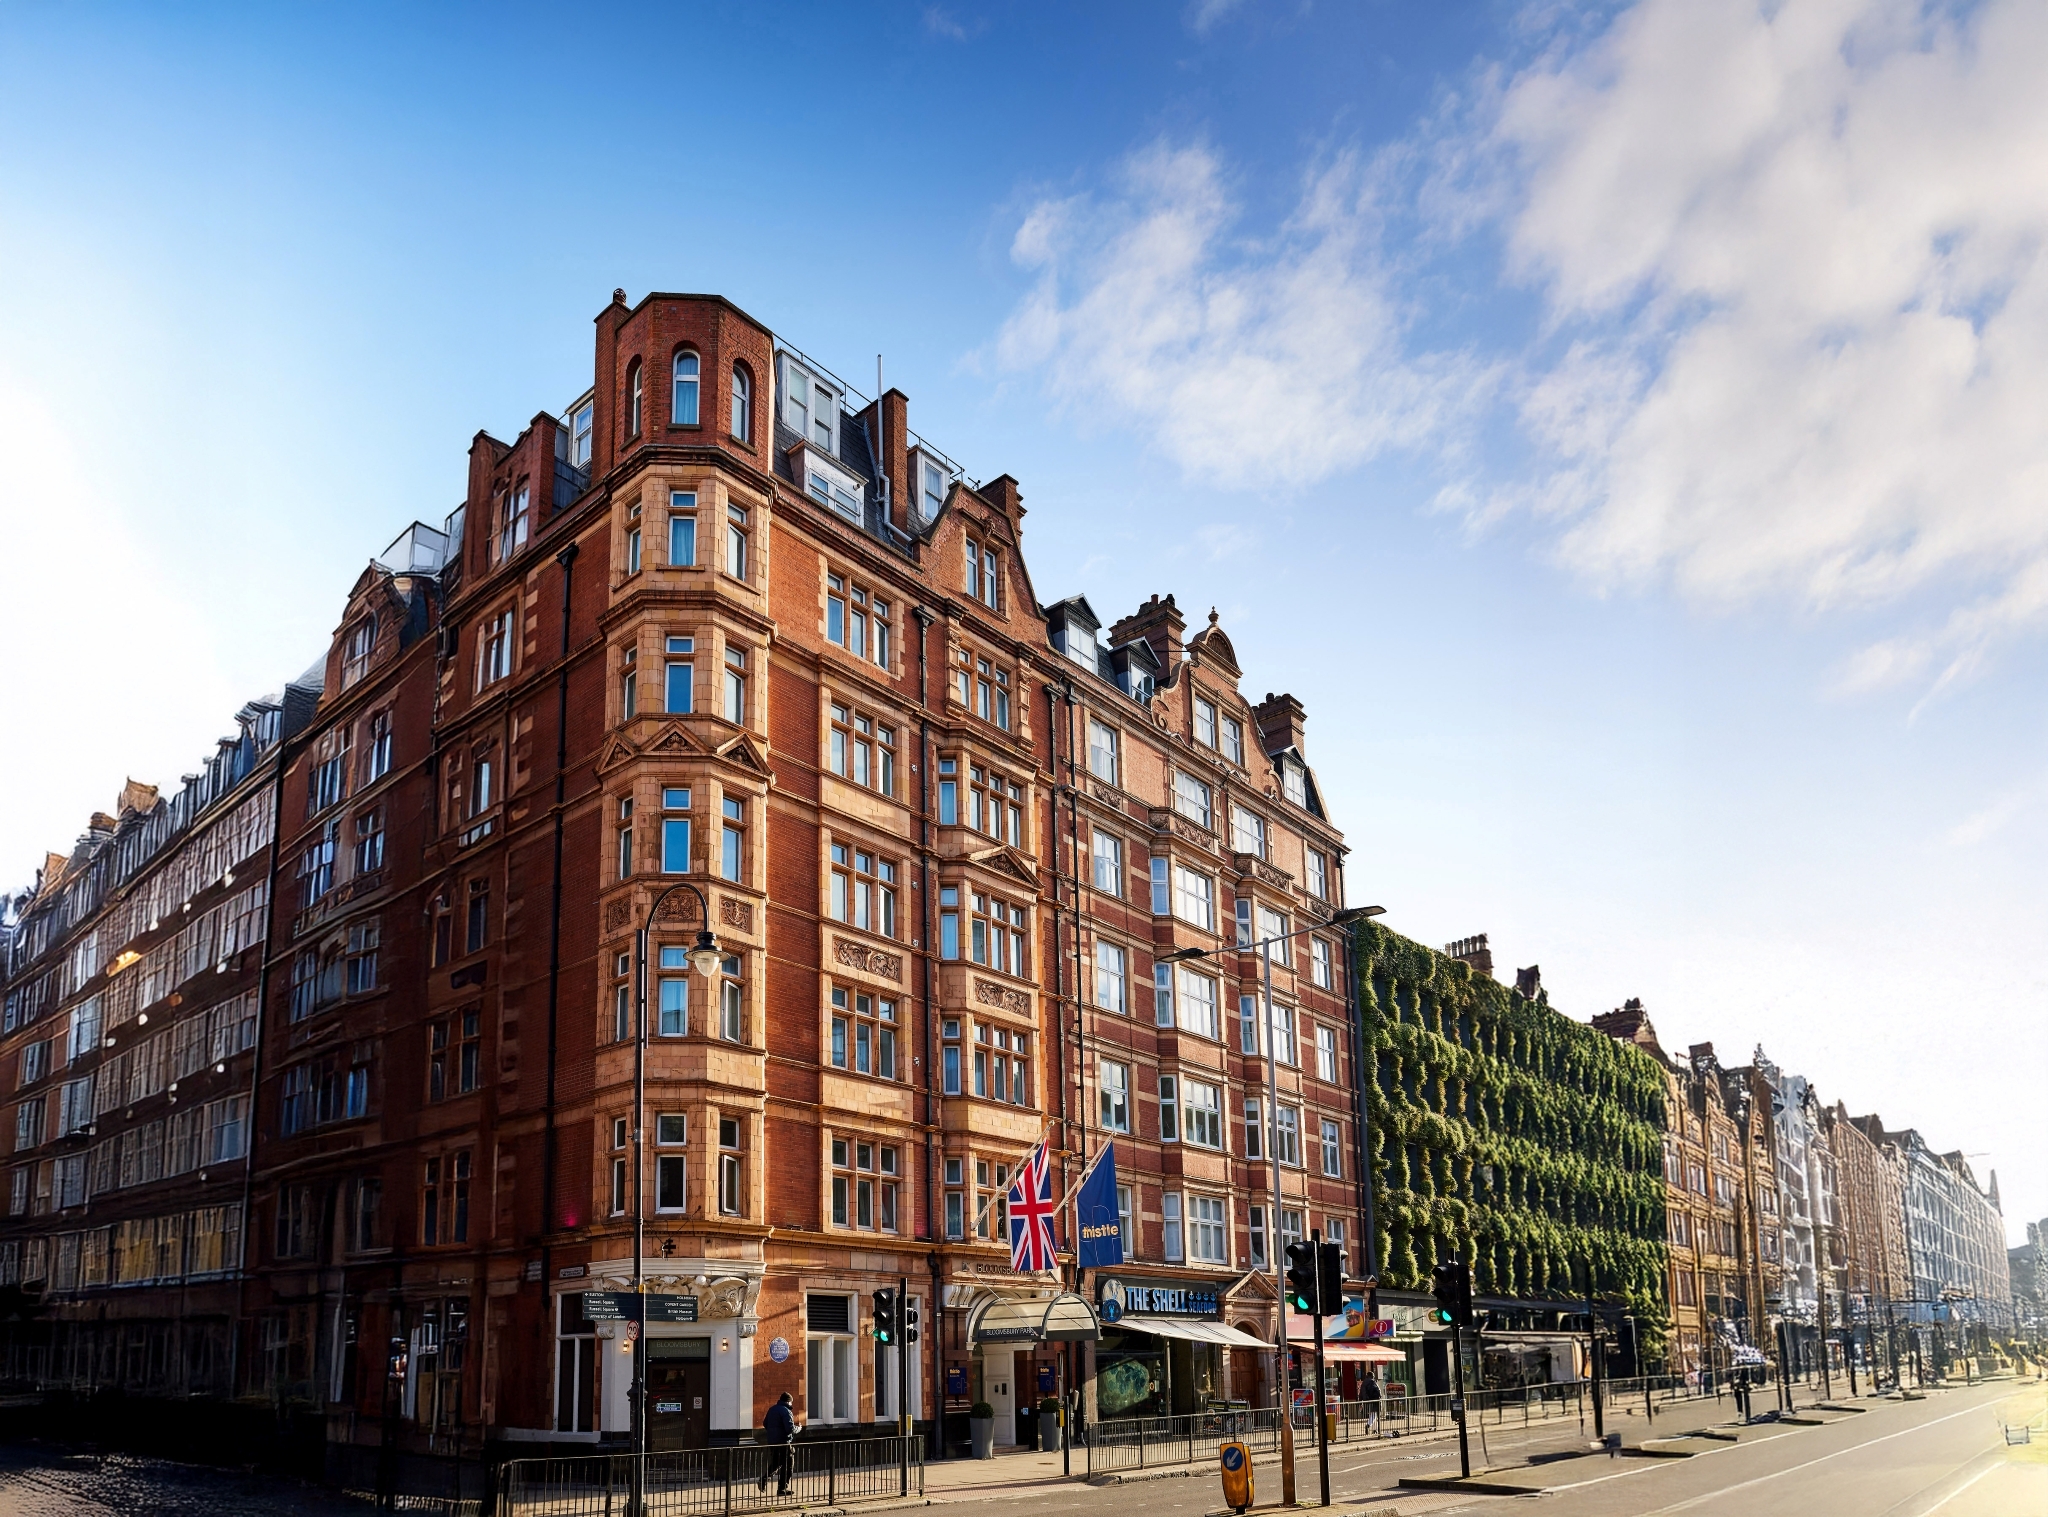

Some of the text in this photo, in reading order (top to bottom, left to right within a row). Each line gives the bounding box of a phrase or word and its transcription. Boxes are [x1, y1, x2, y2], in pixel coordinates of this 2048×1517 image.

[1082, 1224, 1119, 1238] thistle
[1126, 1287, 1150, 1311] THE
[1153, 1288, 1188, 1313] SHELL
[1189, 1301, 1217, 1314] SEAFOOD
[628, 1326, 637, 1335] 20
[987, 1328, 1019, 1336] BLOOMSBURY
